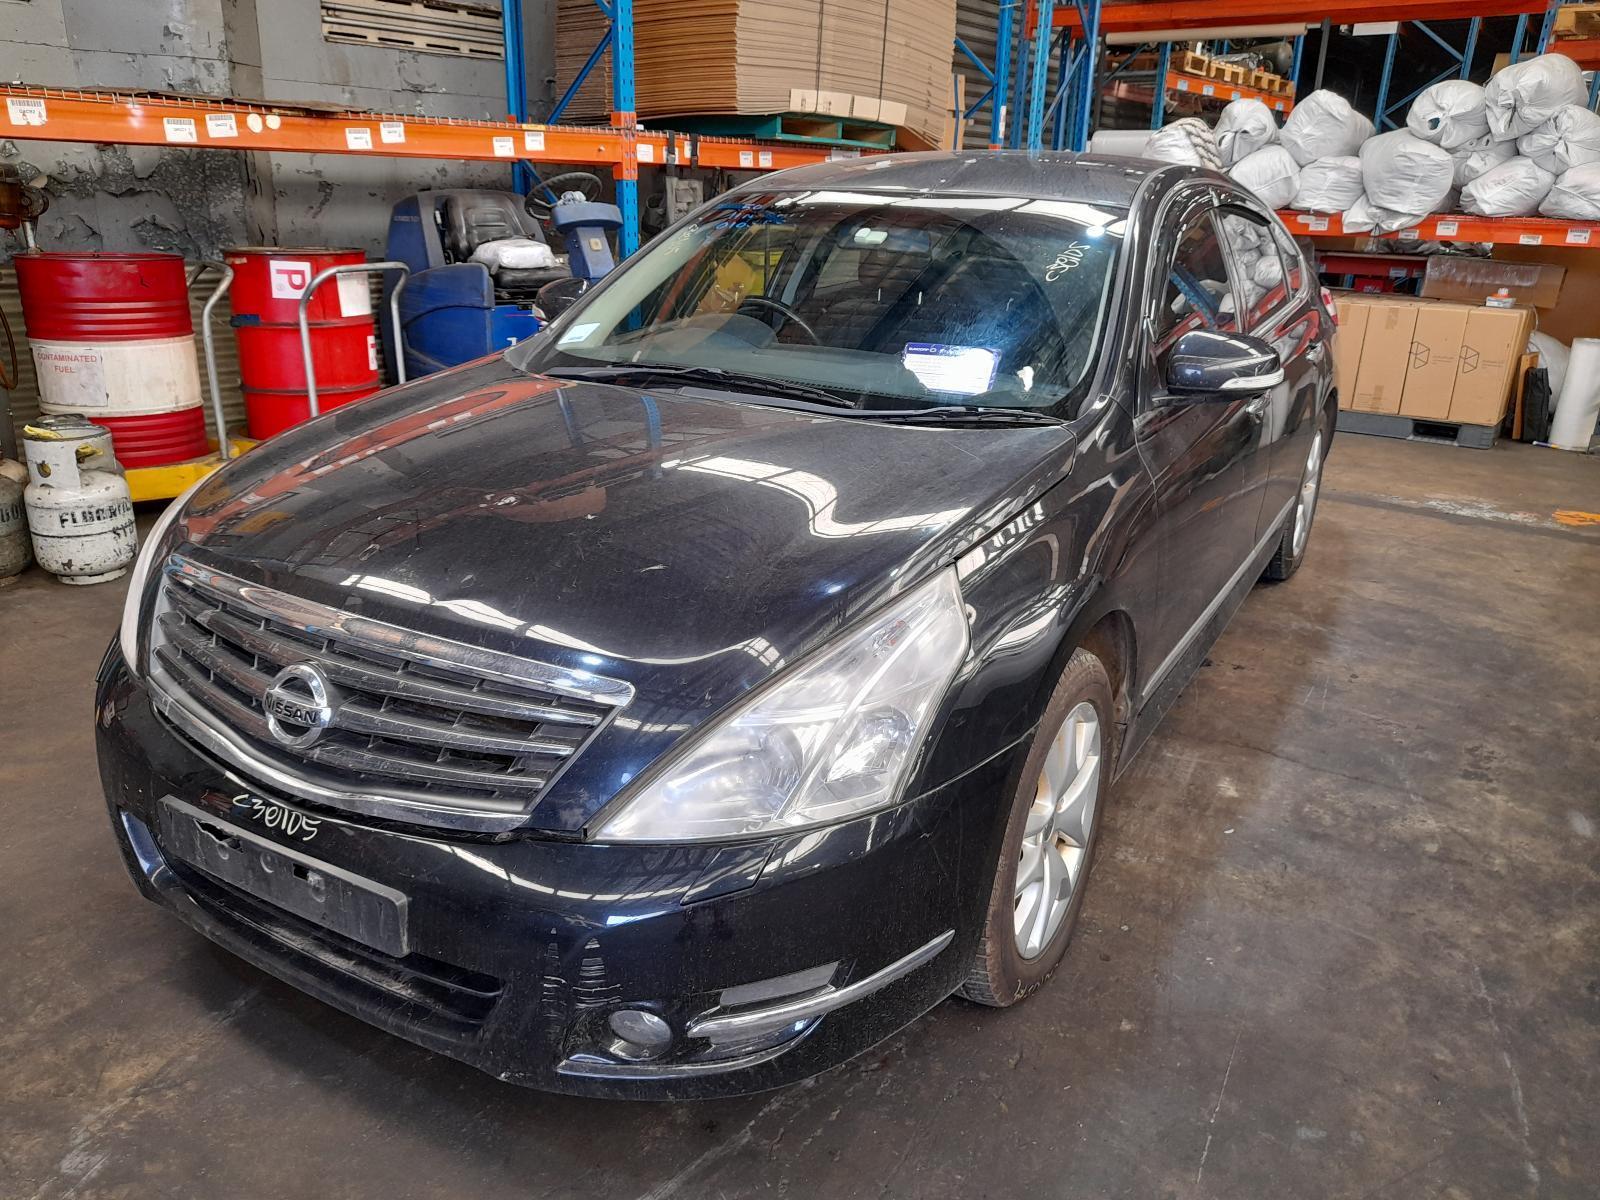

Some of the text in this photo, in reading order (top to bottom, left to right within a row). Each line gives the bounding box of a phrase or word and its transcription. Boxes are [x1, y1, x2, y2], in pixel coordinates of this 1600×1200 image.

[276, 269, 307, 291] P
[37, 352, 97, 363] CONTAMINATED
[55, 365, 75, 374] FUEL
[265, 691, 317, 724] NISSAN
